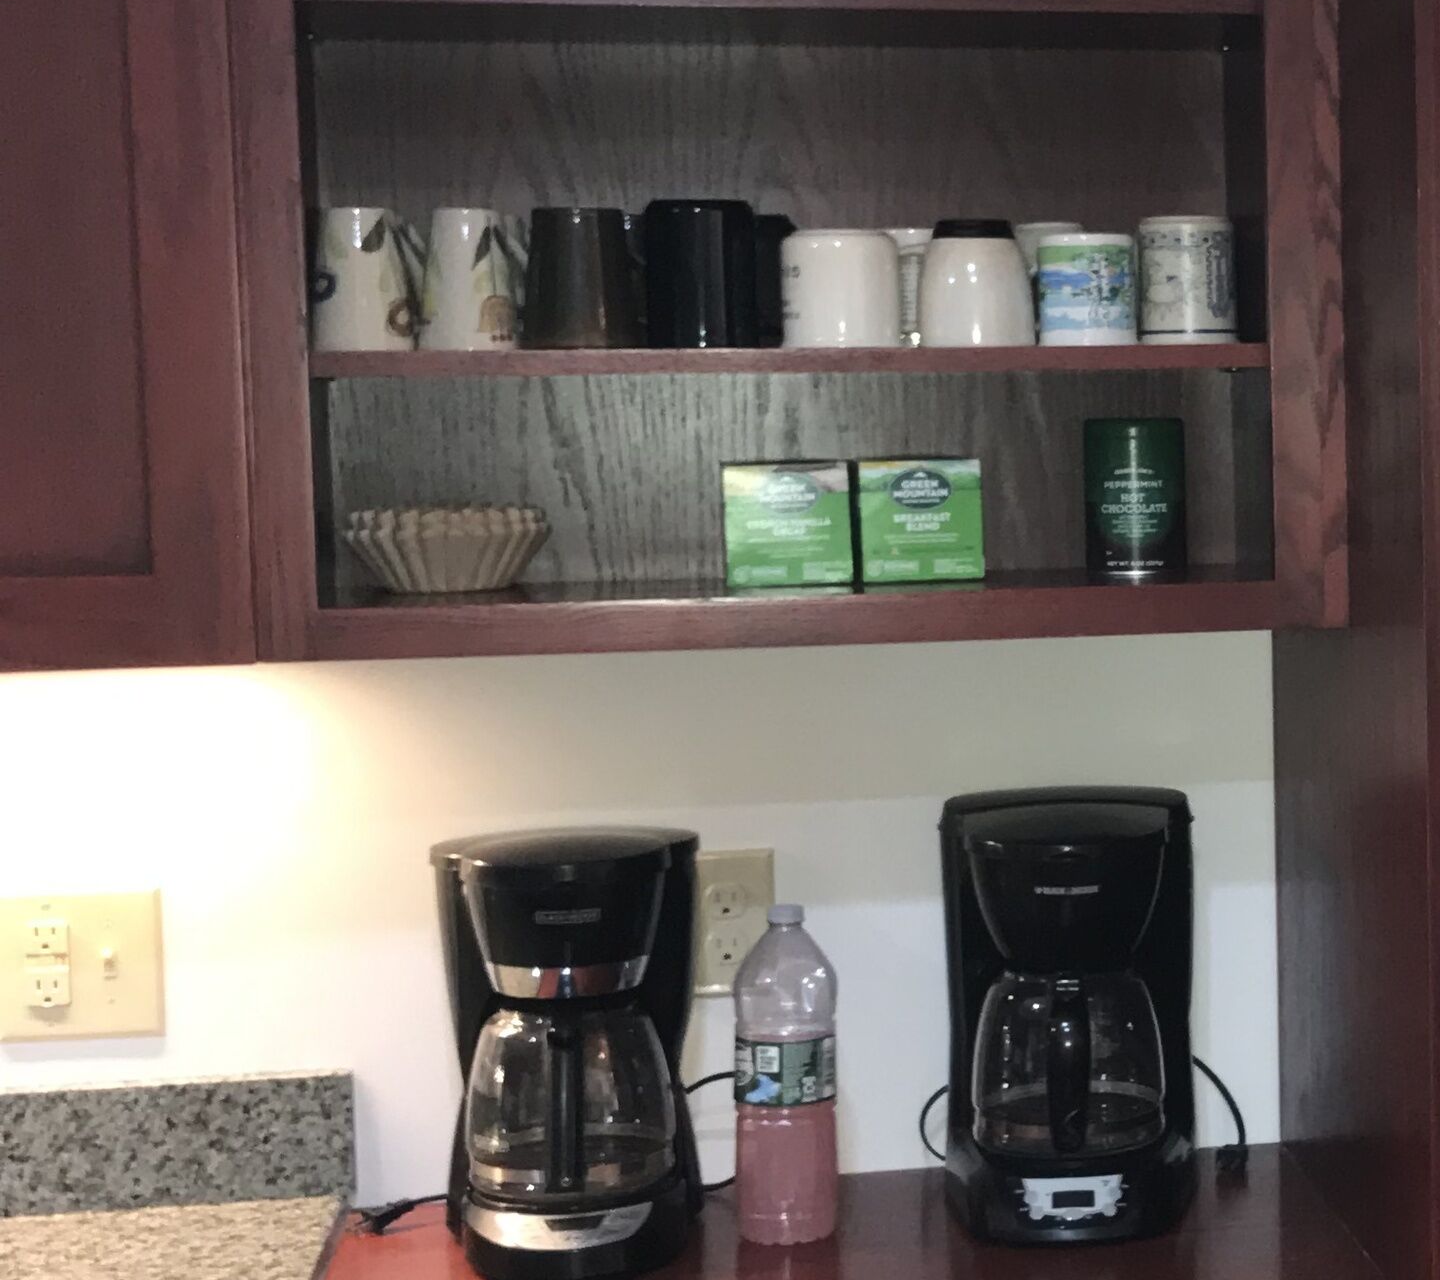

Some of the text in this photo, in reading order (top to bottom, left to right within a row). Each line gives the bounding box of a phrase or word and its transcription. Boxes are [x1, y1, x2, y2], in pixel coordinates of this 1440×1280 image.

[1104, 480, 1163, 489] PEPPERMINT
[892, 488, 948, 499] MOUNTAIN
[1120, 493, 1145, 503] HOT
[1101, 503, 1167, 514] CHOCOLATE
